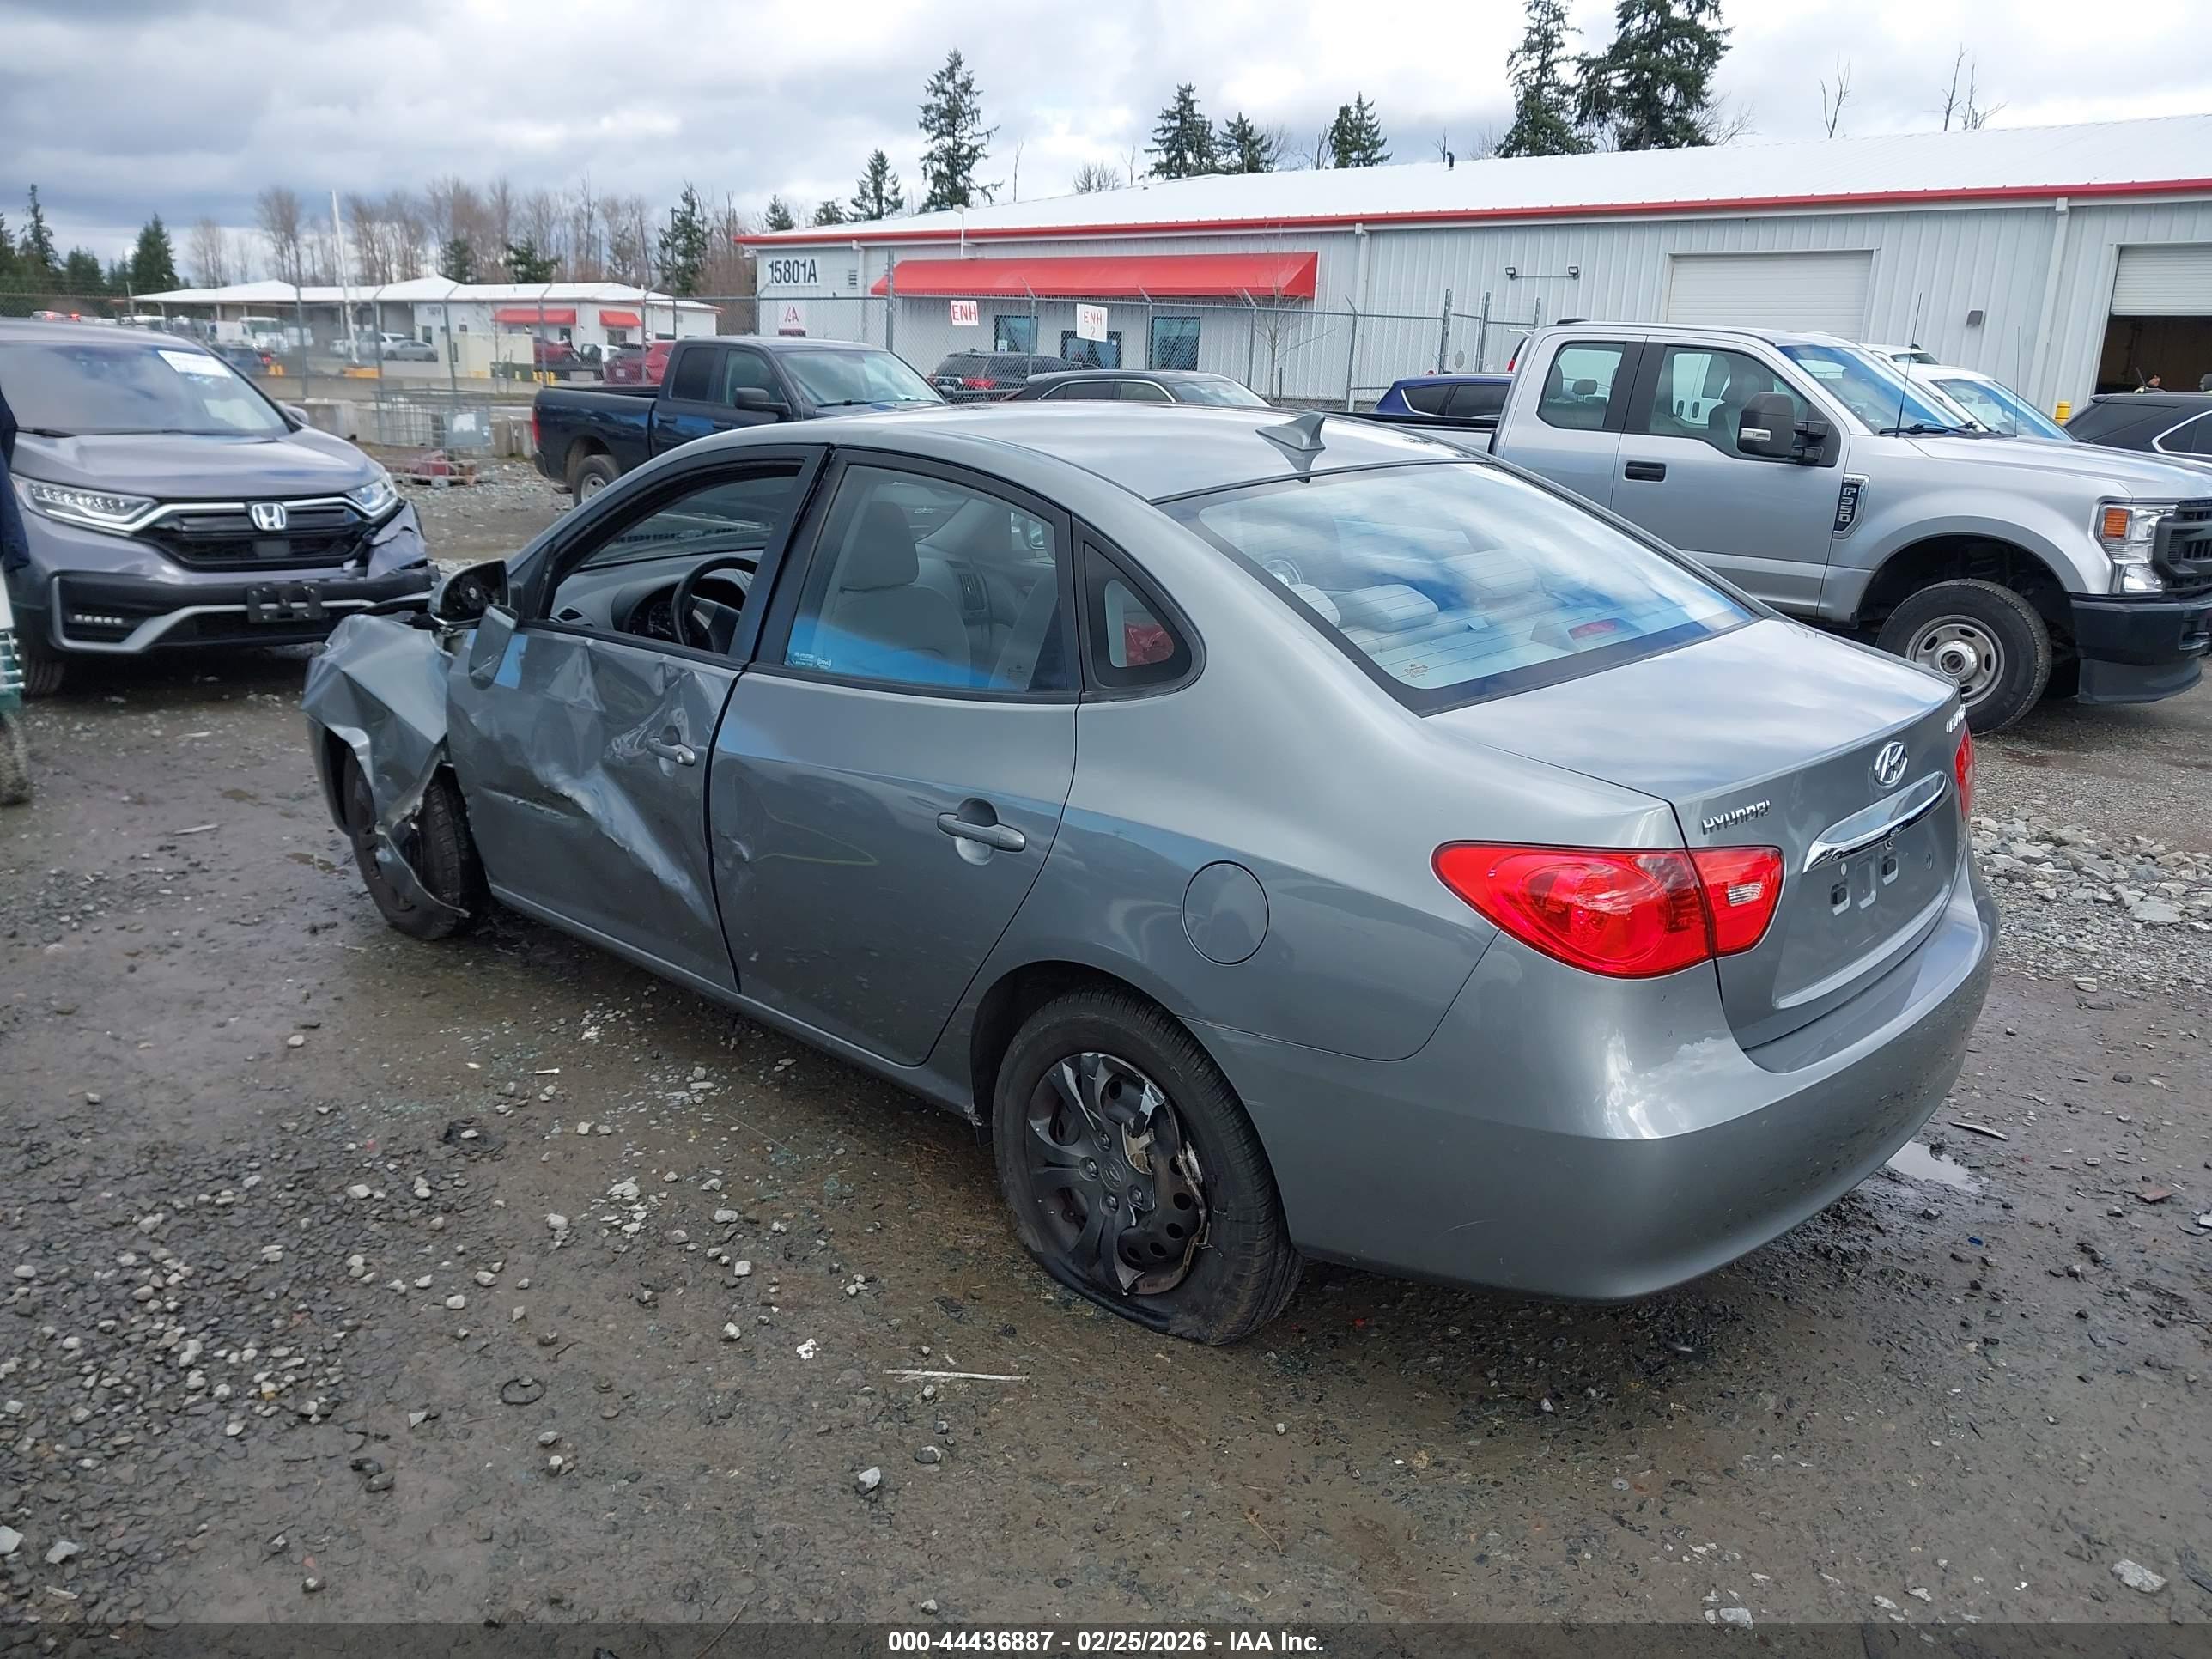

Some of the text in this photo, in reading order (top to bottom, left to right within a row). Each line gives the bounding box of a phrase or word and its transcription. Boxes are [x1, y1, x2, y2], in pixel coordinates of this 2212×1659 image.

[768, 259, 817, 284] 15801A
[952, 304, 977, 321] ENH
[1084, 311, 1103, 325] ENH
[1091, 326, 1096, 338] 2
[1838, 487, 1857, 523] F350
[1702, 799, 1771, 836] HYUNDAI
